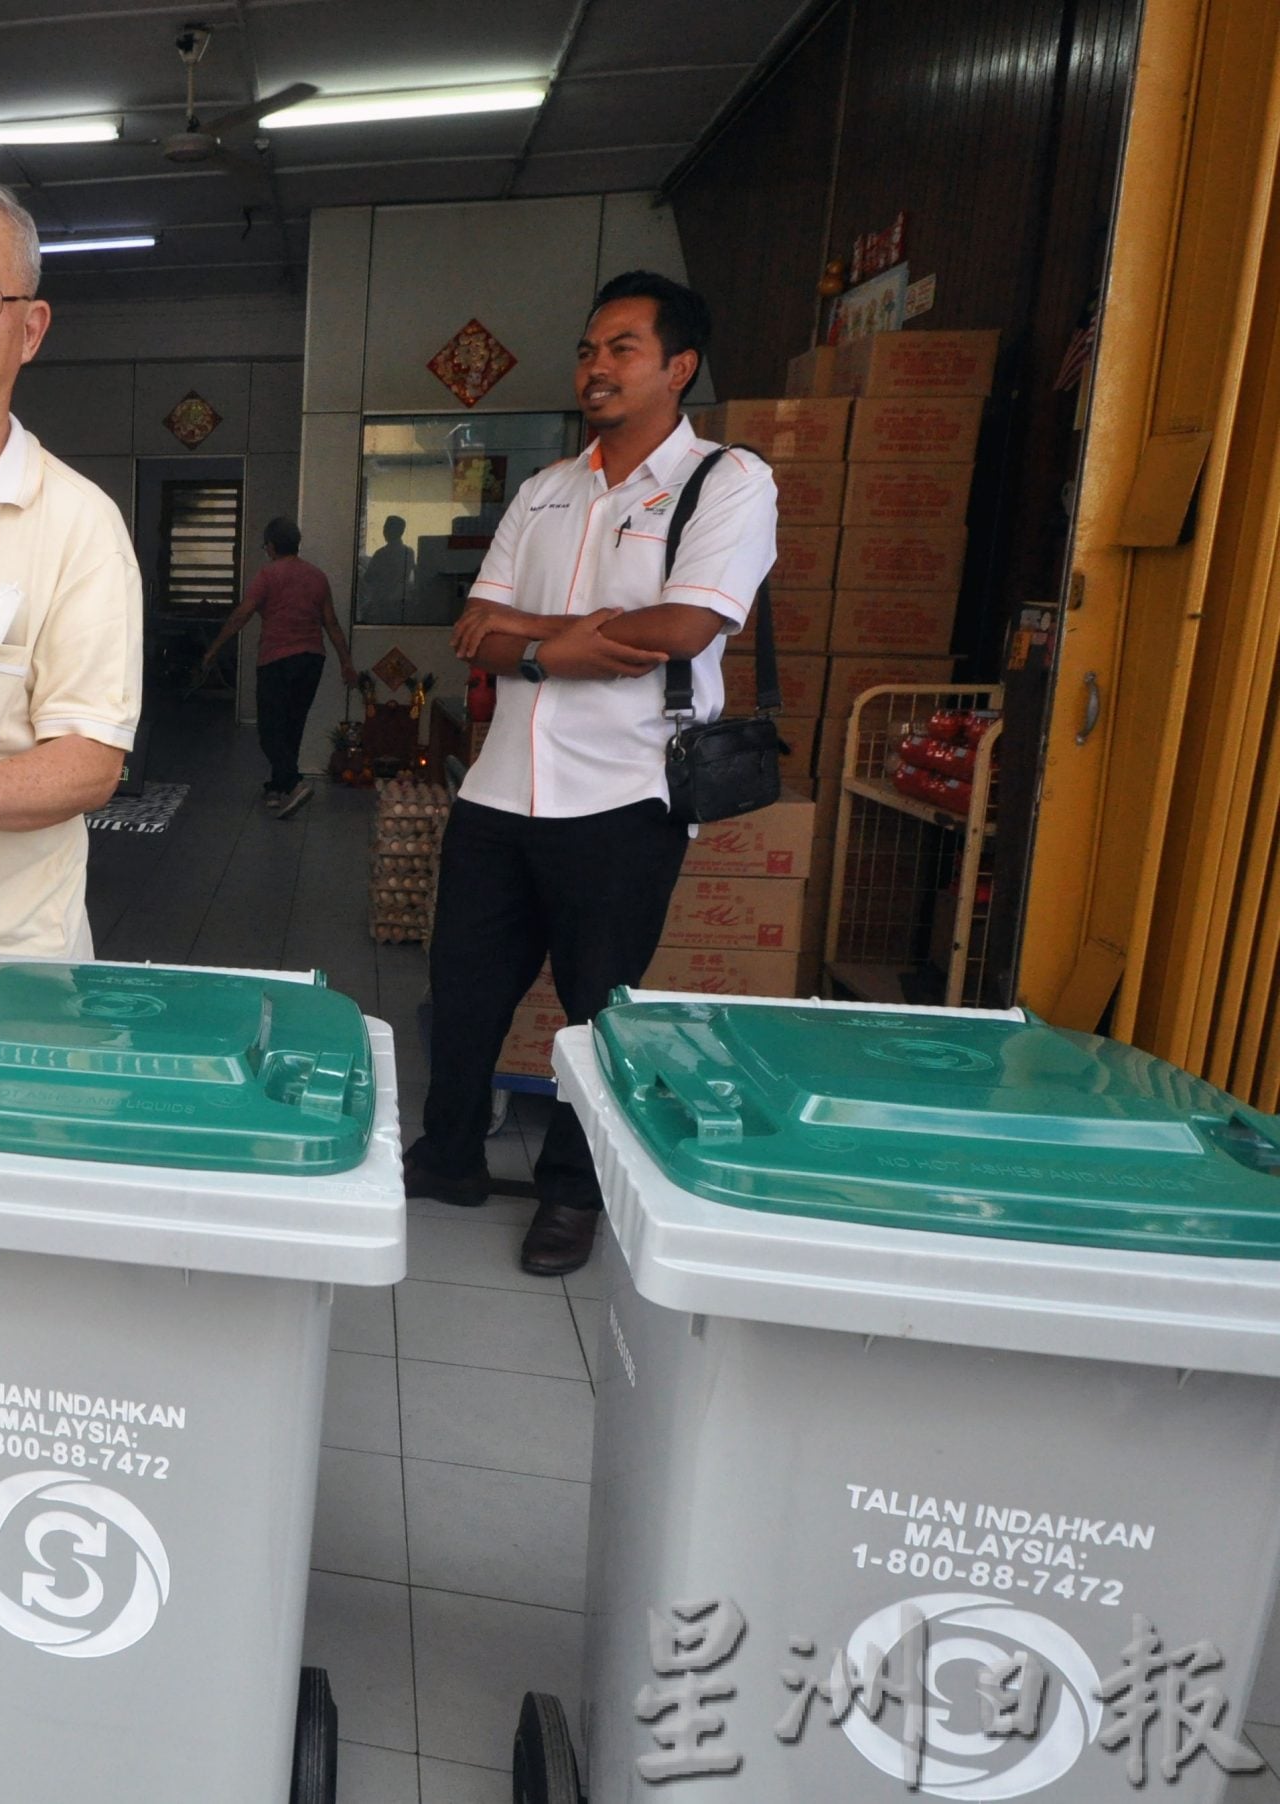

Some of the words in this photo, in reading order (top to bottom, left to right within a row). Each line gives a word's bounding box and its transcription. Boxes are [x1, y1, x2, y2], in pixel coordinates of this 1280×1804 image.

[125, 1098, 196, 1115] LIQUIDS
[876, 1155, 911, 1169] NO
[914, 1158, 961, 1172] HOT
[969, 1162, 1043, 1179] ASHES
[1050, 1170, 1097, 1184] AND
[47, 1389, 186, 1430] INDAHKAN
[845, 1483, 968, 1526] TALIAN
[974, 1503, 1156, 1551] INDAHKAN
[903, 1521, 1088, 1571] MALAYSIA:
[851, 1542, 1125, 1607] 1-800-88-7472
